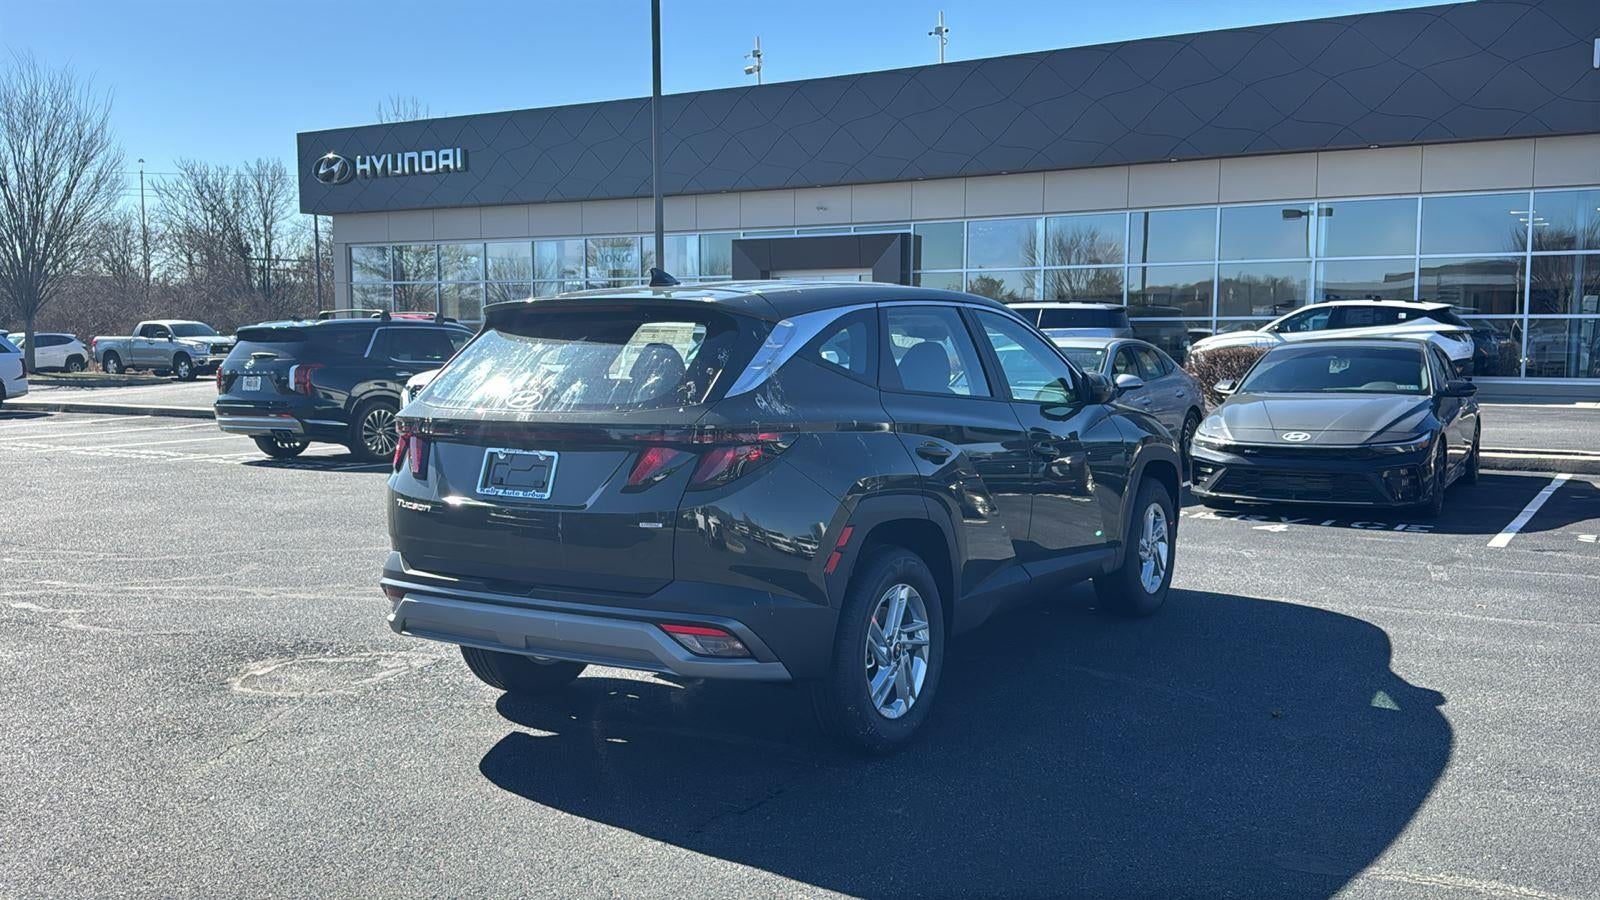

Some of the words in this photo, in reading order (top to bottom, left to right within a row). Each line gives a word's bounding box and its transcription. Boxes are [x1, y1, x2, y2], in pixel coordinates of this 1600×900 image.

[355, 148, 463, 176] HYUNDAI
[501, 489, 520, 497] Auto
[522, 490, 546, 499] Group
[396, 498, 432, 513] TUCSON
